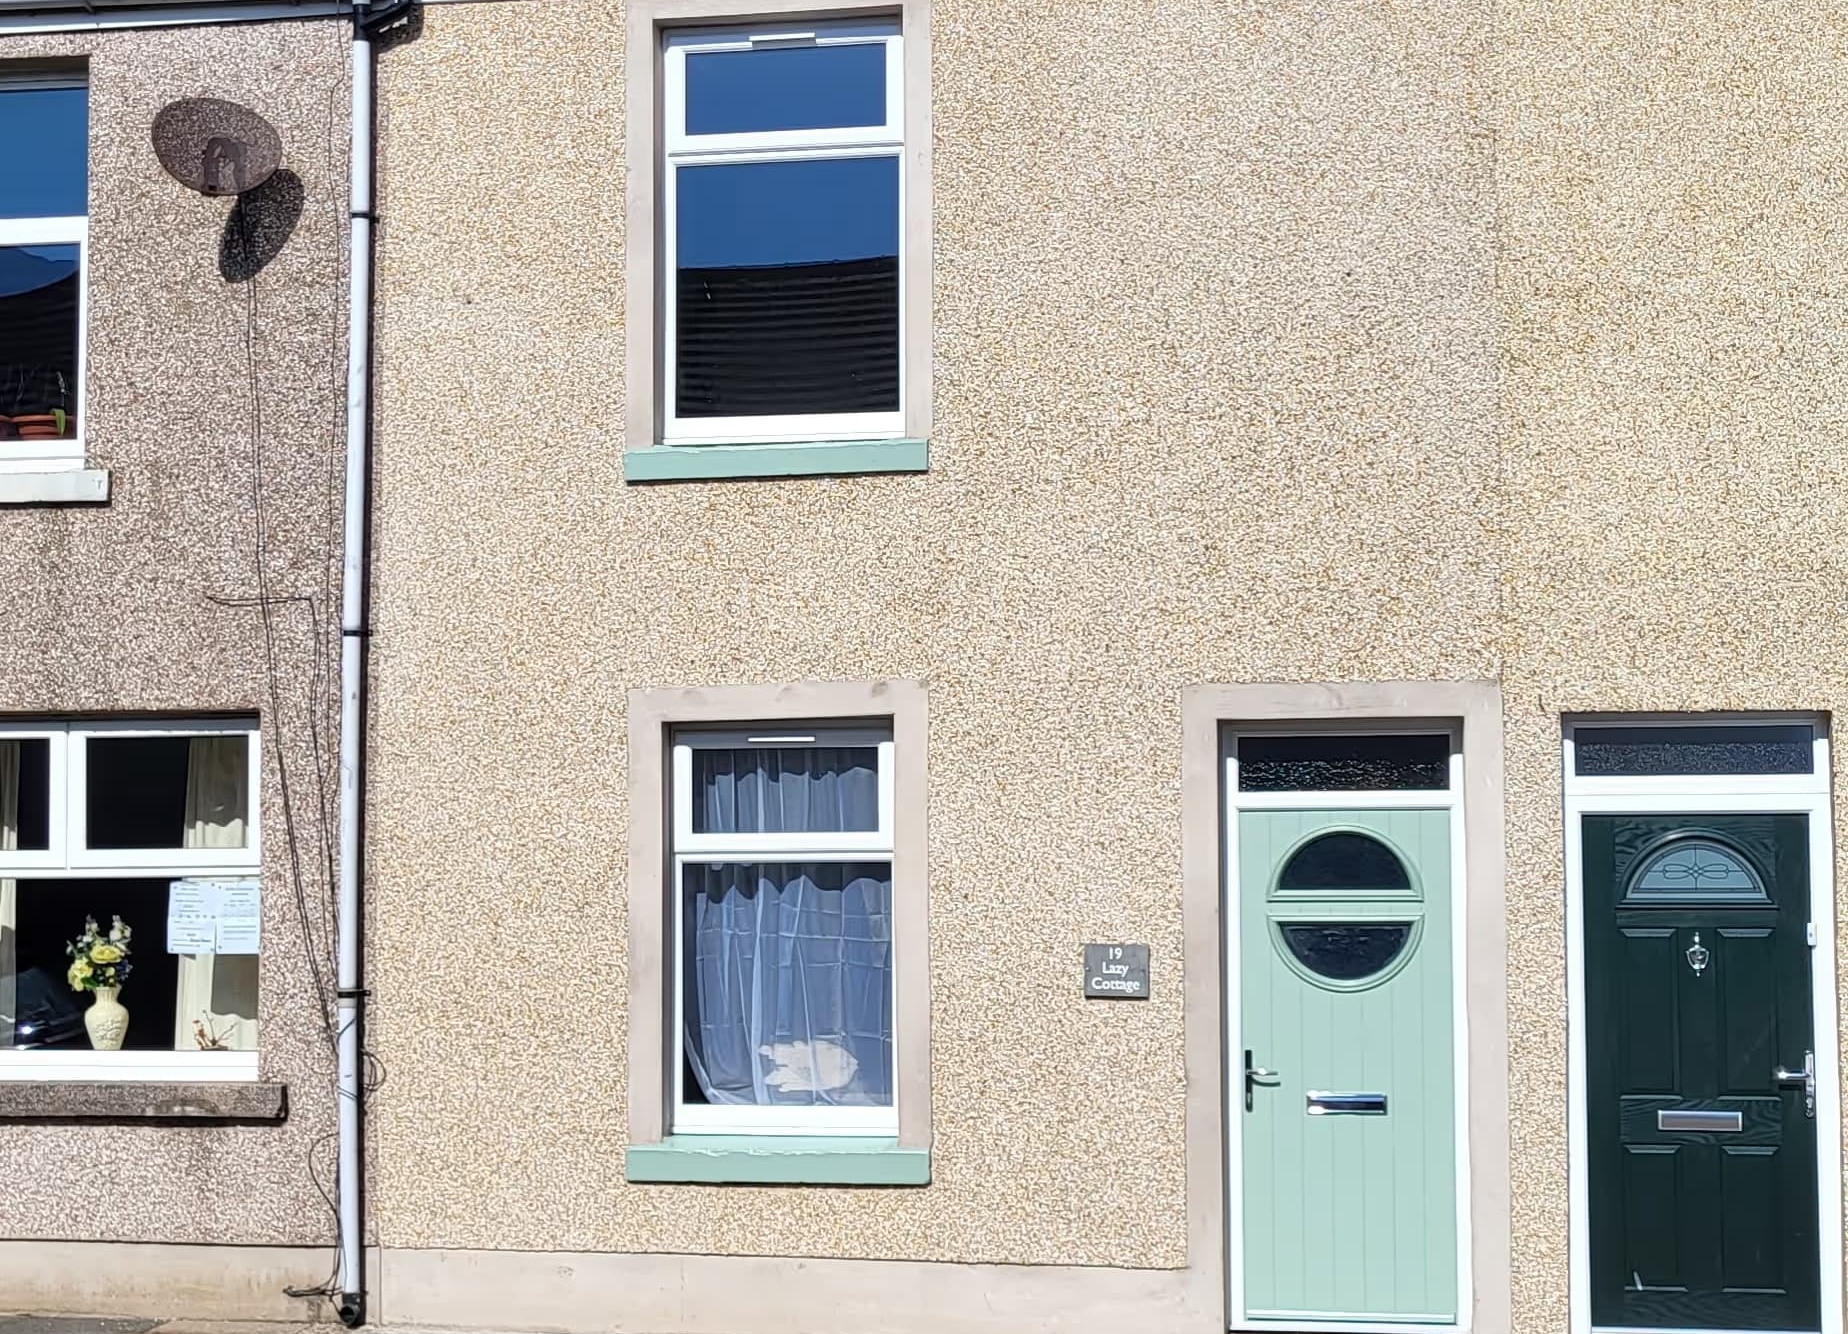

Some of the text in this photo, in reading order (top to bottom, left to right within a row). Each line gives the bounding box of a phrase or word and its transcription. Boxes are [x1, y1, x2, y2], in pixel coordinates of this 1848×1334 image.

[1109, 947, 1122, 960] 19
[1102, 961, 1129, 978] Lazy
[1091, 977, 1141, 993] Cottage
